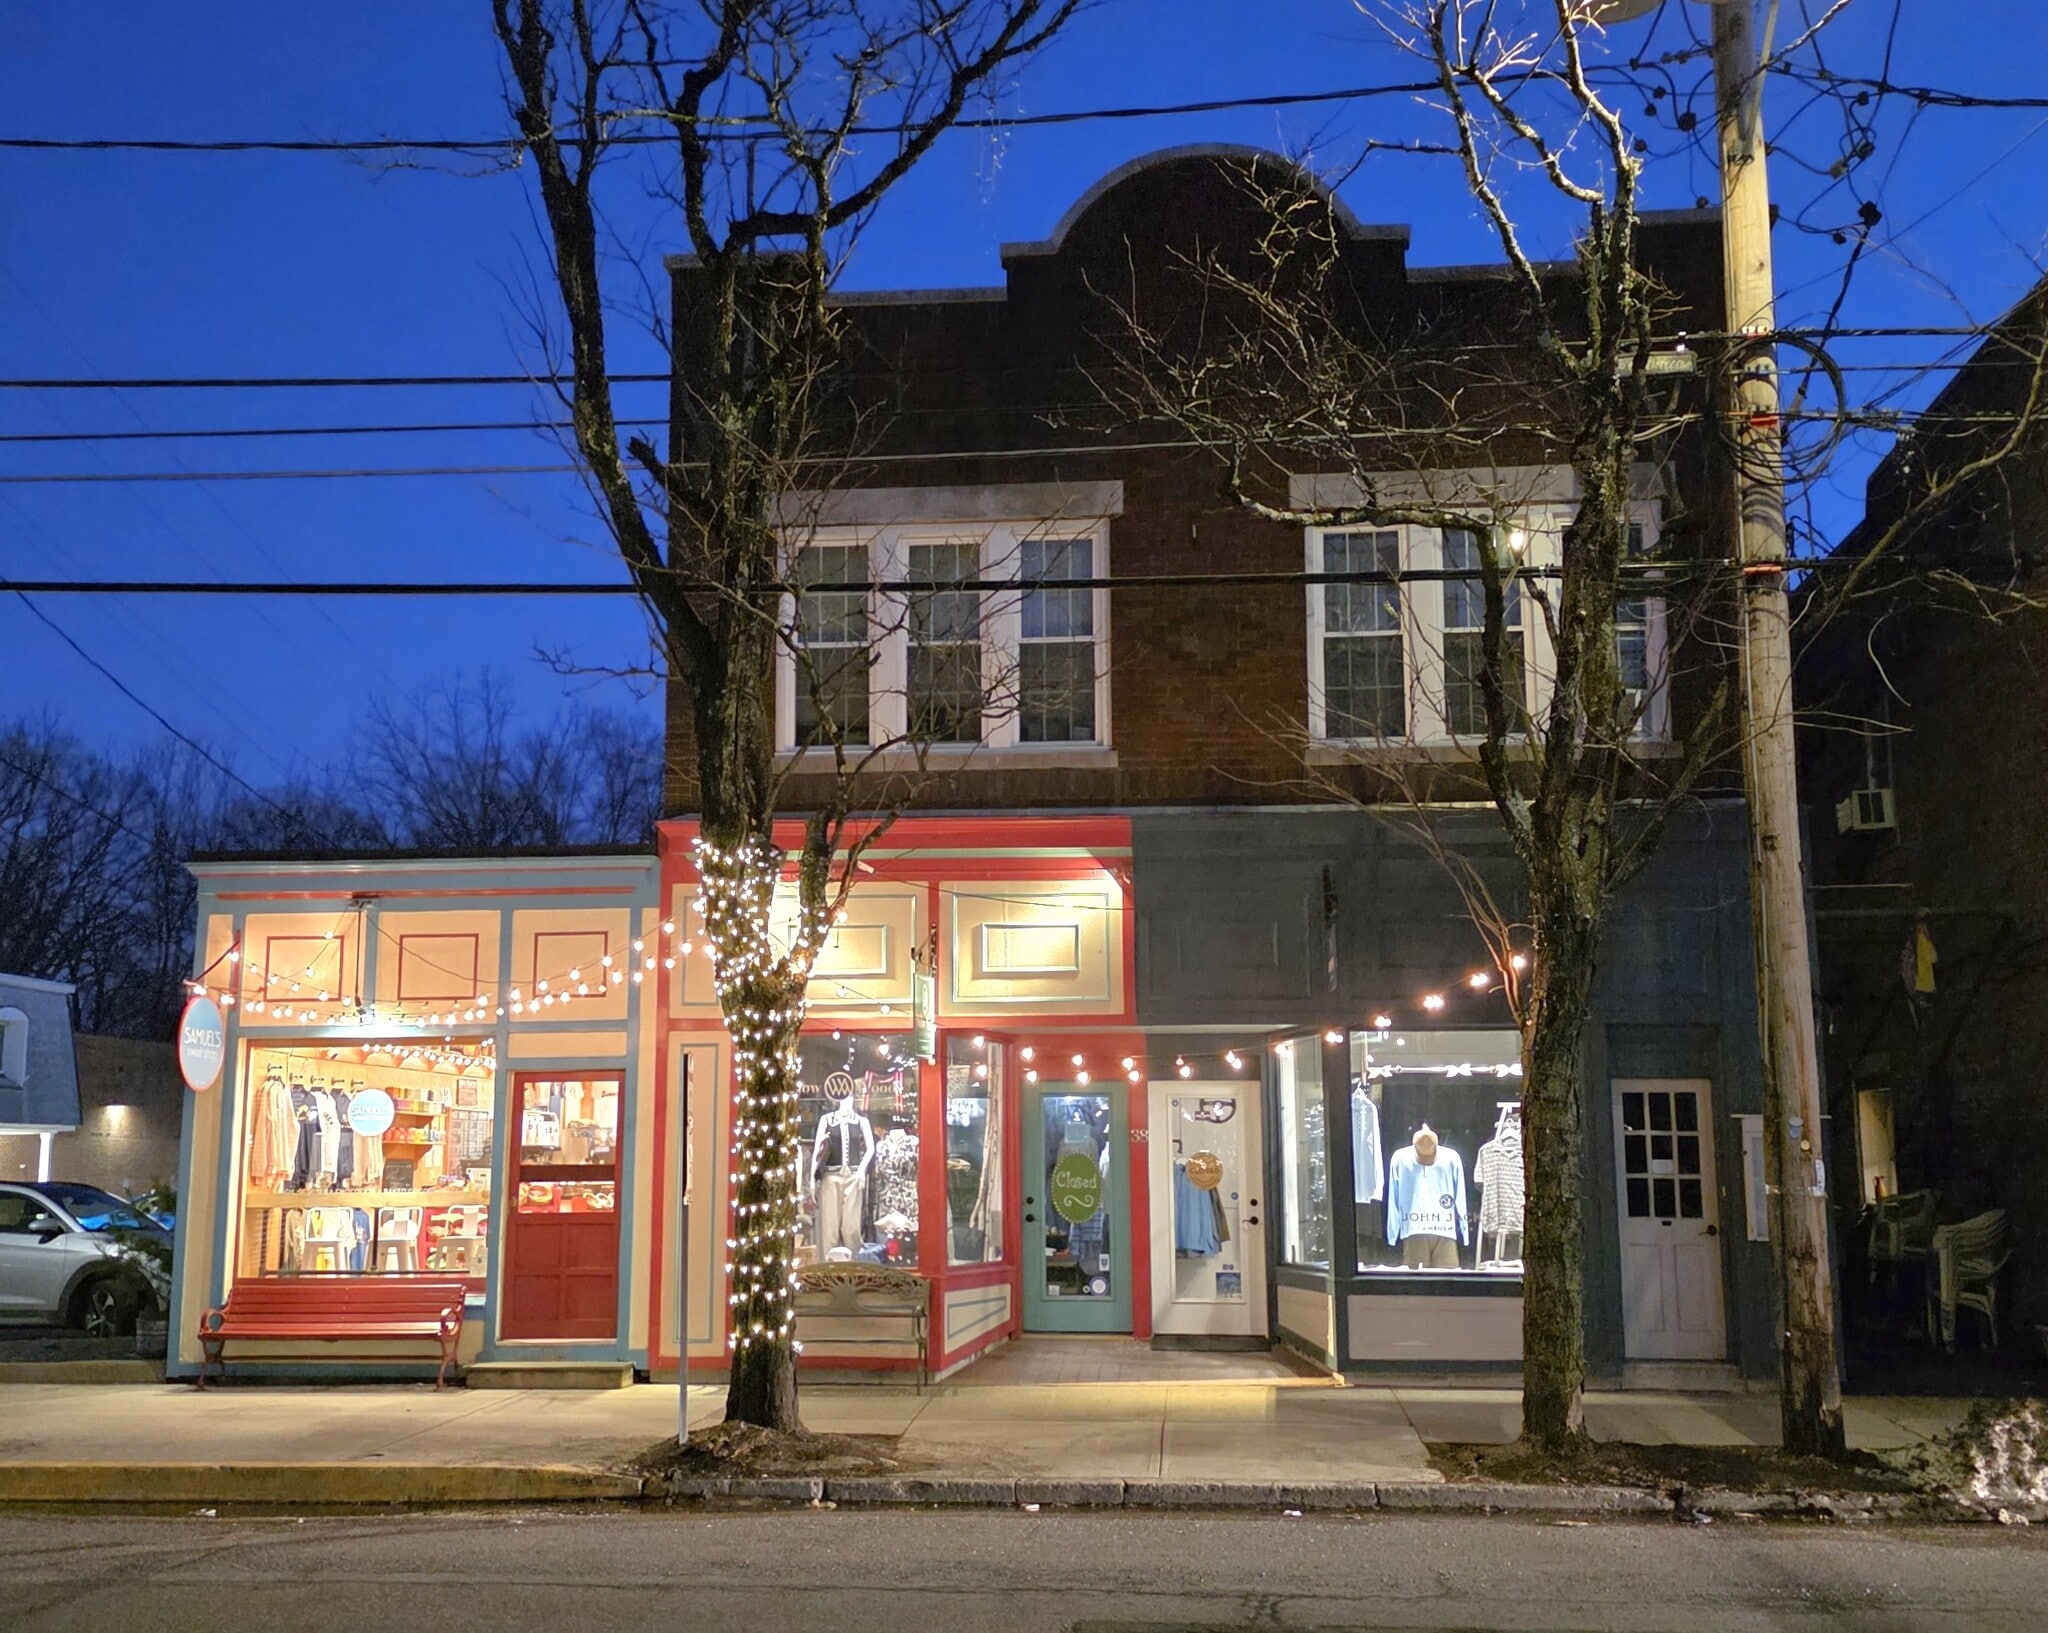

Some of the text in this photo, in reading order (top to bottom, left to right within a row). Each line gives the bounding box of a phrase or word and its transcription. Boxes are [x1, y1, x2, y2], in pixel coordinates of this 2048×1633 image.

[184, 1027, 222, 1048] SAMUEL'S
[1130, 1129, 1149, 1143] 38
[1056, 1171, 1097, 1189] Closed
[1402, 1212, 1440, 1222] JOHN
